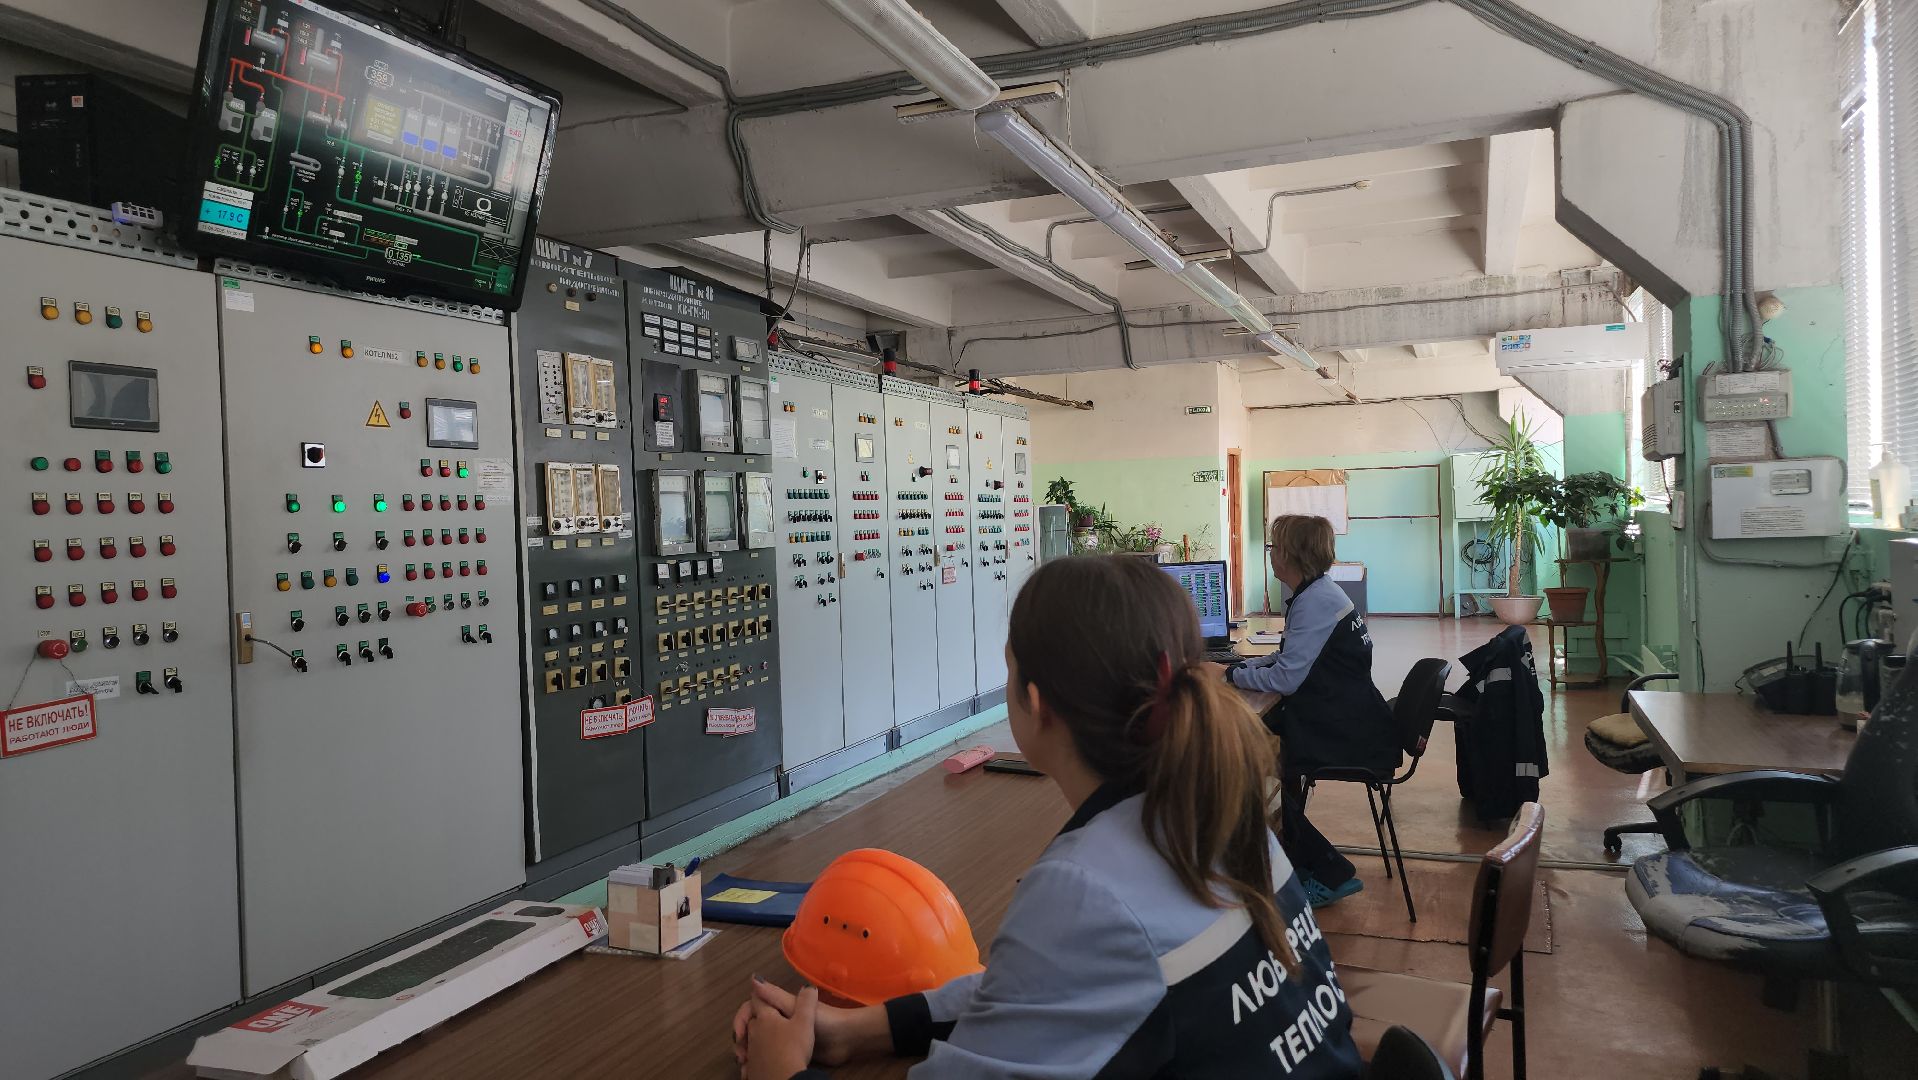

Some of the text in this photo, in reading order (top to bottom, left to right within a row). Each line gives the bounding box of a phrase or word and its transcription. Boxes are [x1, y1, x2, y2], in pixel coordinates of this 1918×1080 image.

[387, 247, 410, 264] 0.135
[535, 237, 571, 264] ЩИТ
[365, 275, 387, 285] PHILIPS
[669, 273, 697, 296] ЩИТ
[364, 349, 399, 361] КОТЕЛ №2
[8, 704, 89, 733] НЕ ВКЛЮЧАТЬ!
[584, 715, 593, 726] НЕ
[9, 721, 91, 745] РАБОТАЮТ ЛЮДИ
[1231, 899, 1322, 1026] ЛЮБРЕЦ
[1269, 960, 1346, 1074] ТЕПЛОС
